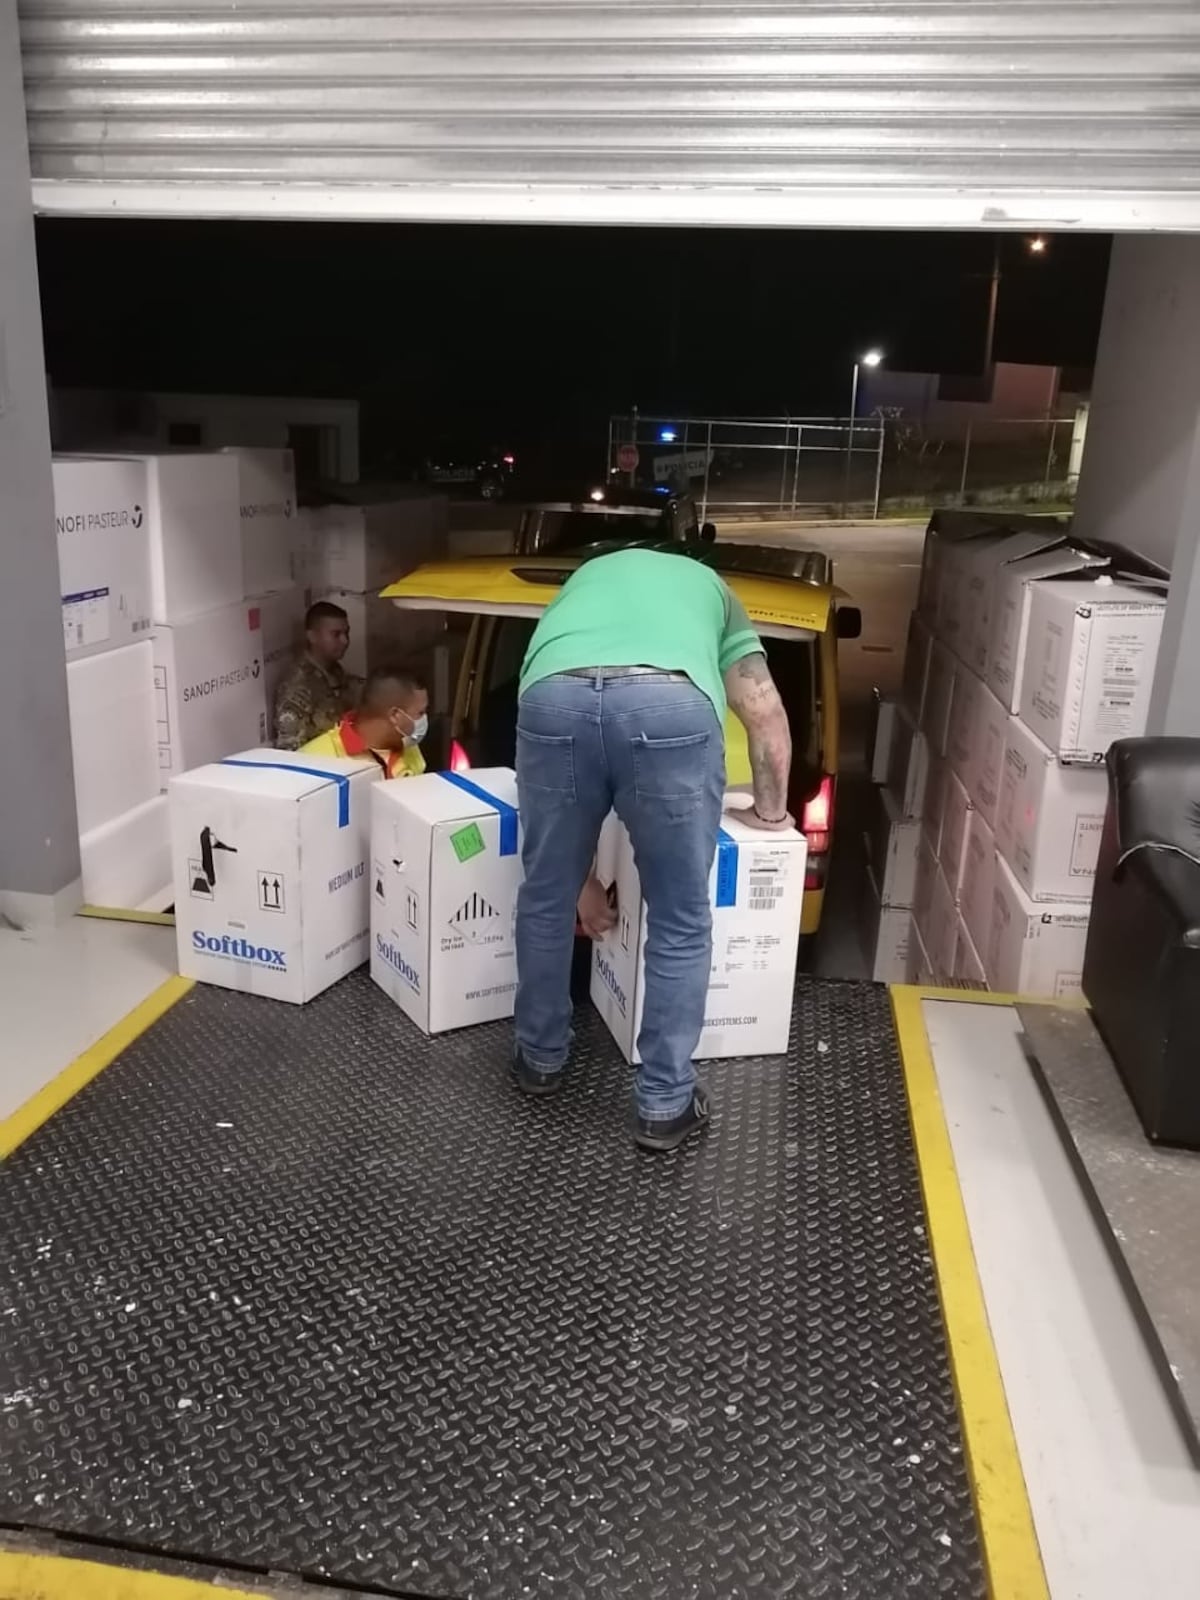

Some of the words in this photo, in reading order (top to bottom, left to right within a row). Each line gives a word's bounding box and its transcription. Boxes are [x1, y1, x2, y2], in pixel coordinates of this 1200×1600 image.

[56, 515, 86, 534] NOFI
[88, 511, 128, 529] PASTEUR
[183, 679, 218, 702] SANOFI
[219, 666, 250, 688] PASTEUR
[328, 868, 353, 894] MEDIUM
[192, 930, 288, 966] Softbox
[376, 932, 420, 989] Softbox
[596, 948, 627, 1012] Softbox
